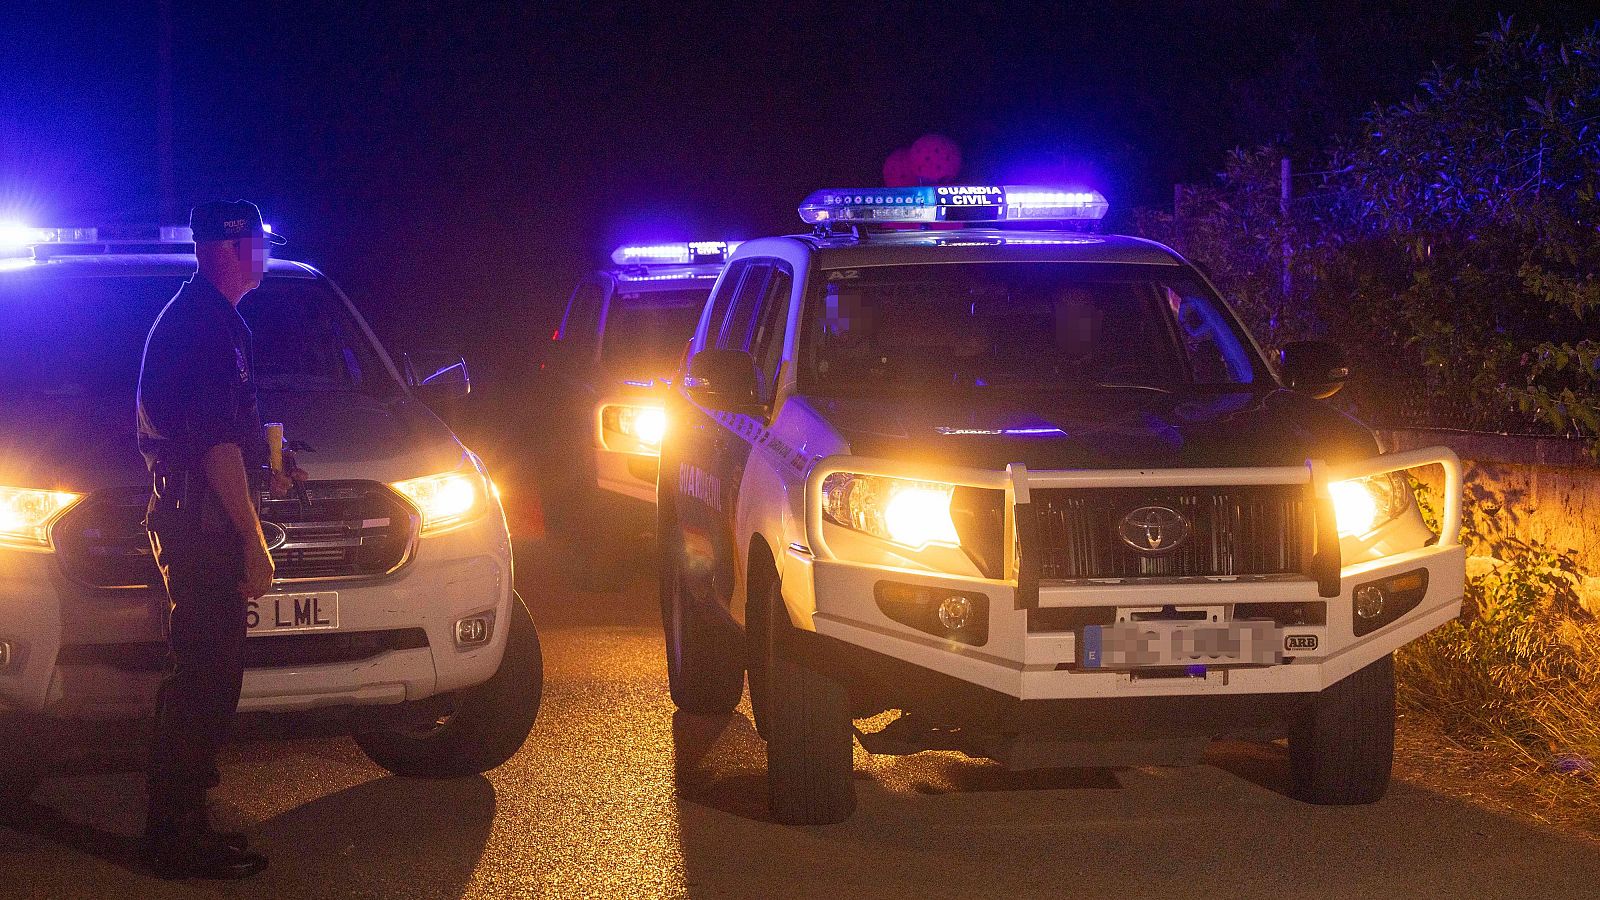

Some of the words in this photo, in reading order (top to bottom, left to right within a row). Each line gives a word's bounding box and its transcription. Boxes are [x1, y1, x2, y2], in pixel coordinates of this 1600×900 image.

[938, 186, 1002, 195] GUARDIA
[952, 195, 991, 205] CIVIL
[275, 597, 330, 627] LML
[1288, 638, 1316, 648] ARB
[1088, 651, 1097, 661] E
